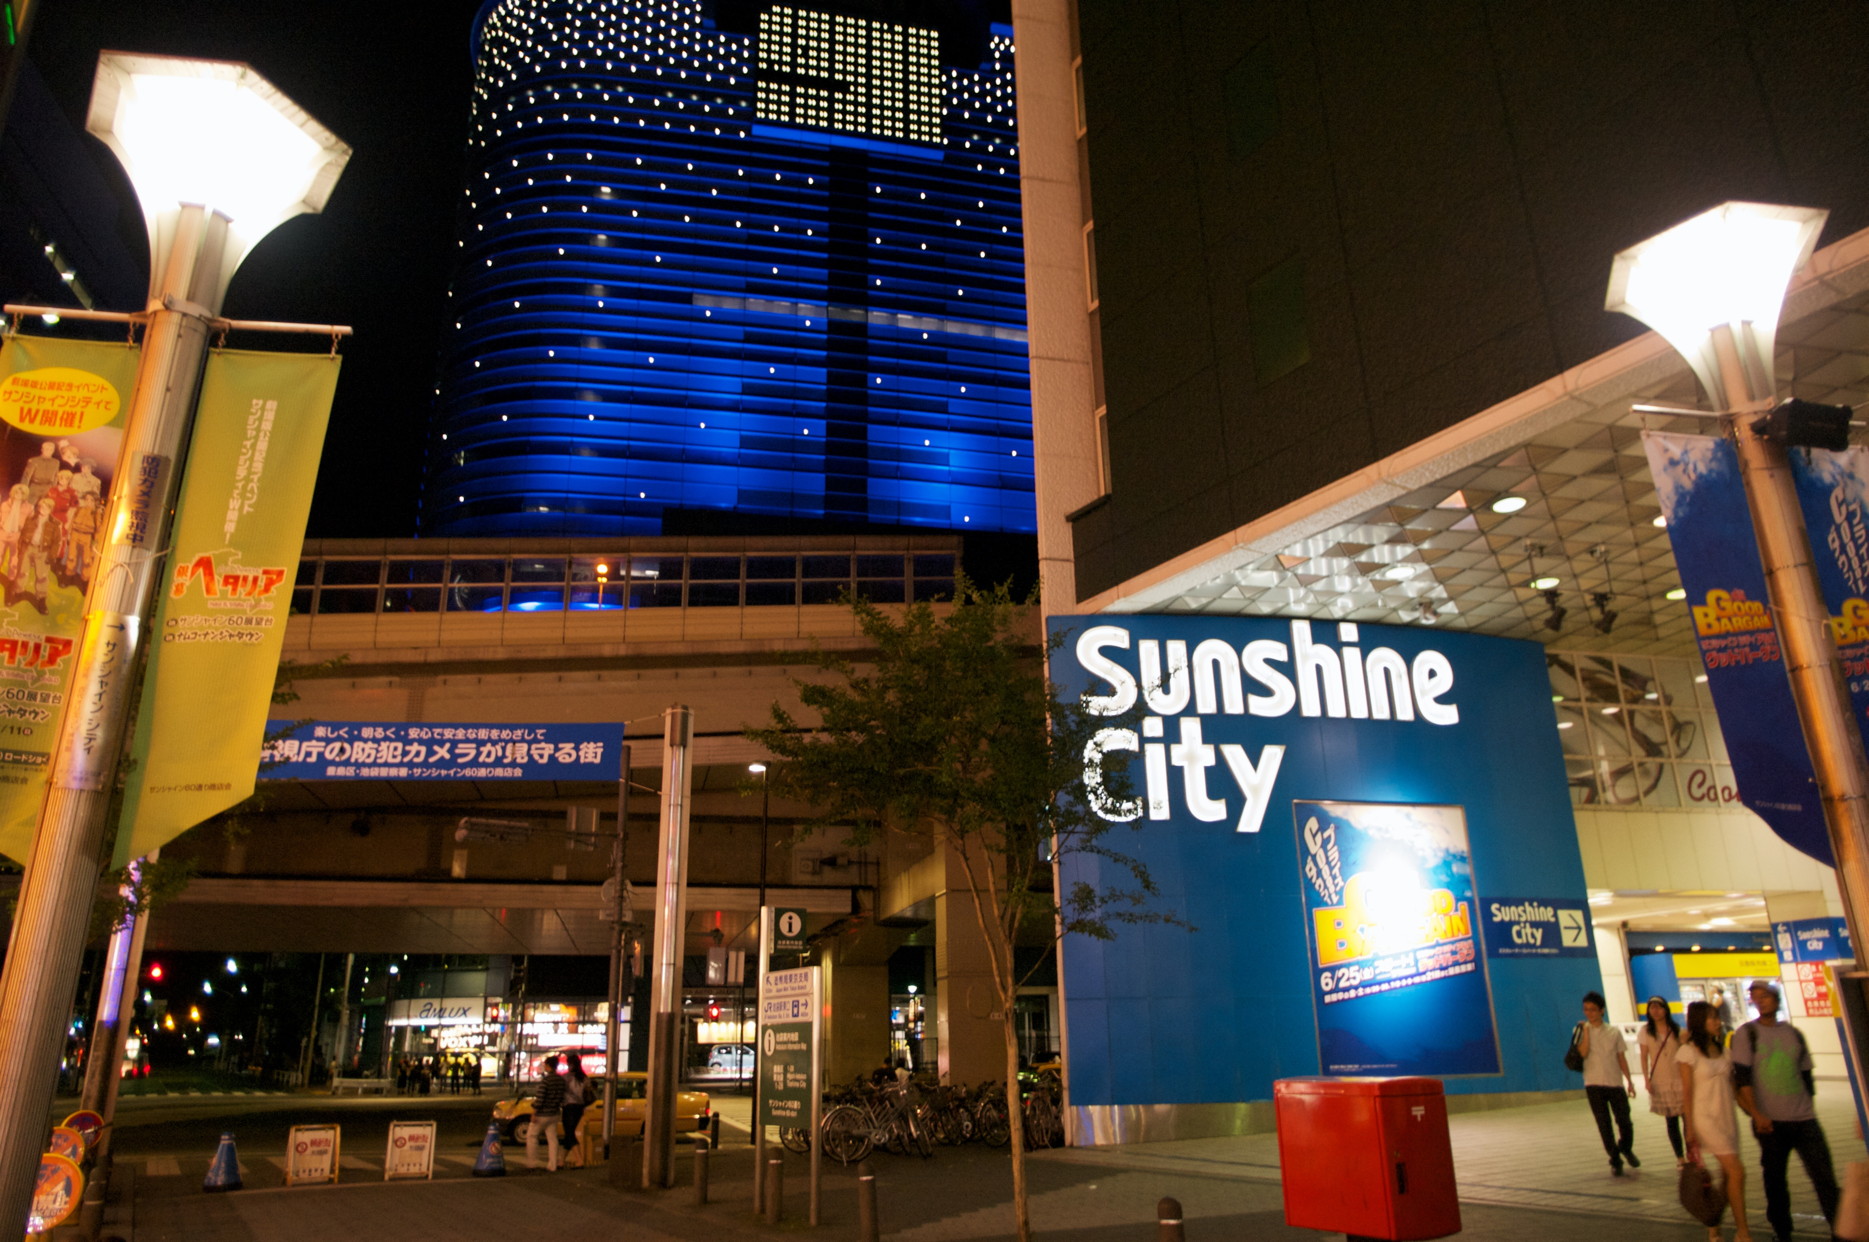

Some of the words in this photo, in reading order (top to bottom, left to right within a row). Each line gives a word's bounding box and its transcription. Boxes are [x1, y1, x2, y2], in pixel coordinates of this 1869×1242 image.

[188, 555, 286, 597] ヘタリア
[1692, 605, 1774, 636] BARGAIN
[1706, 588, 1764, 617] GOOD
[90, 640, 118, 714] サンシャイン
[1075, 619, 1460, 726] Sunshine
[1082, 716, 1286, 833] City
[1490, 901, 1556, 922] Sunshine
[1511, 922, 1543, 946] City
